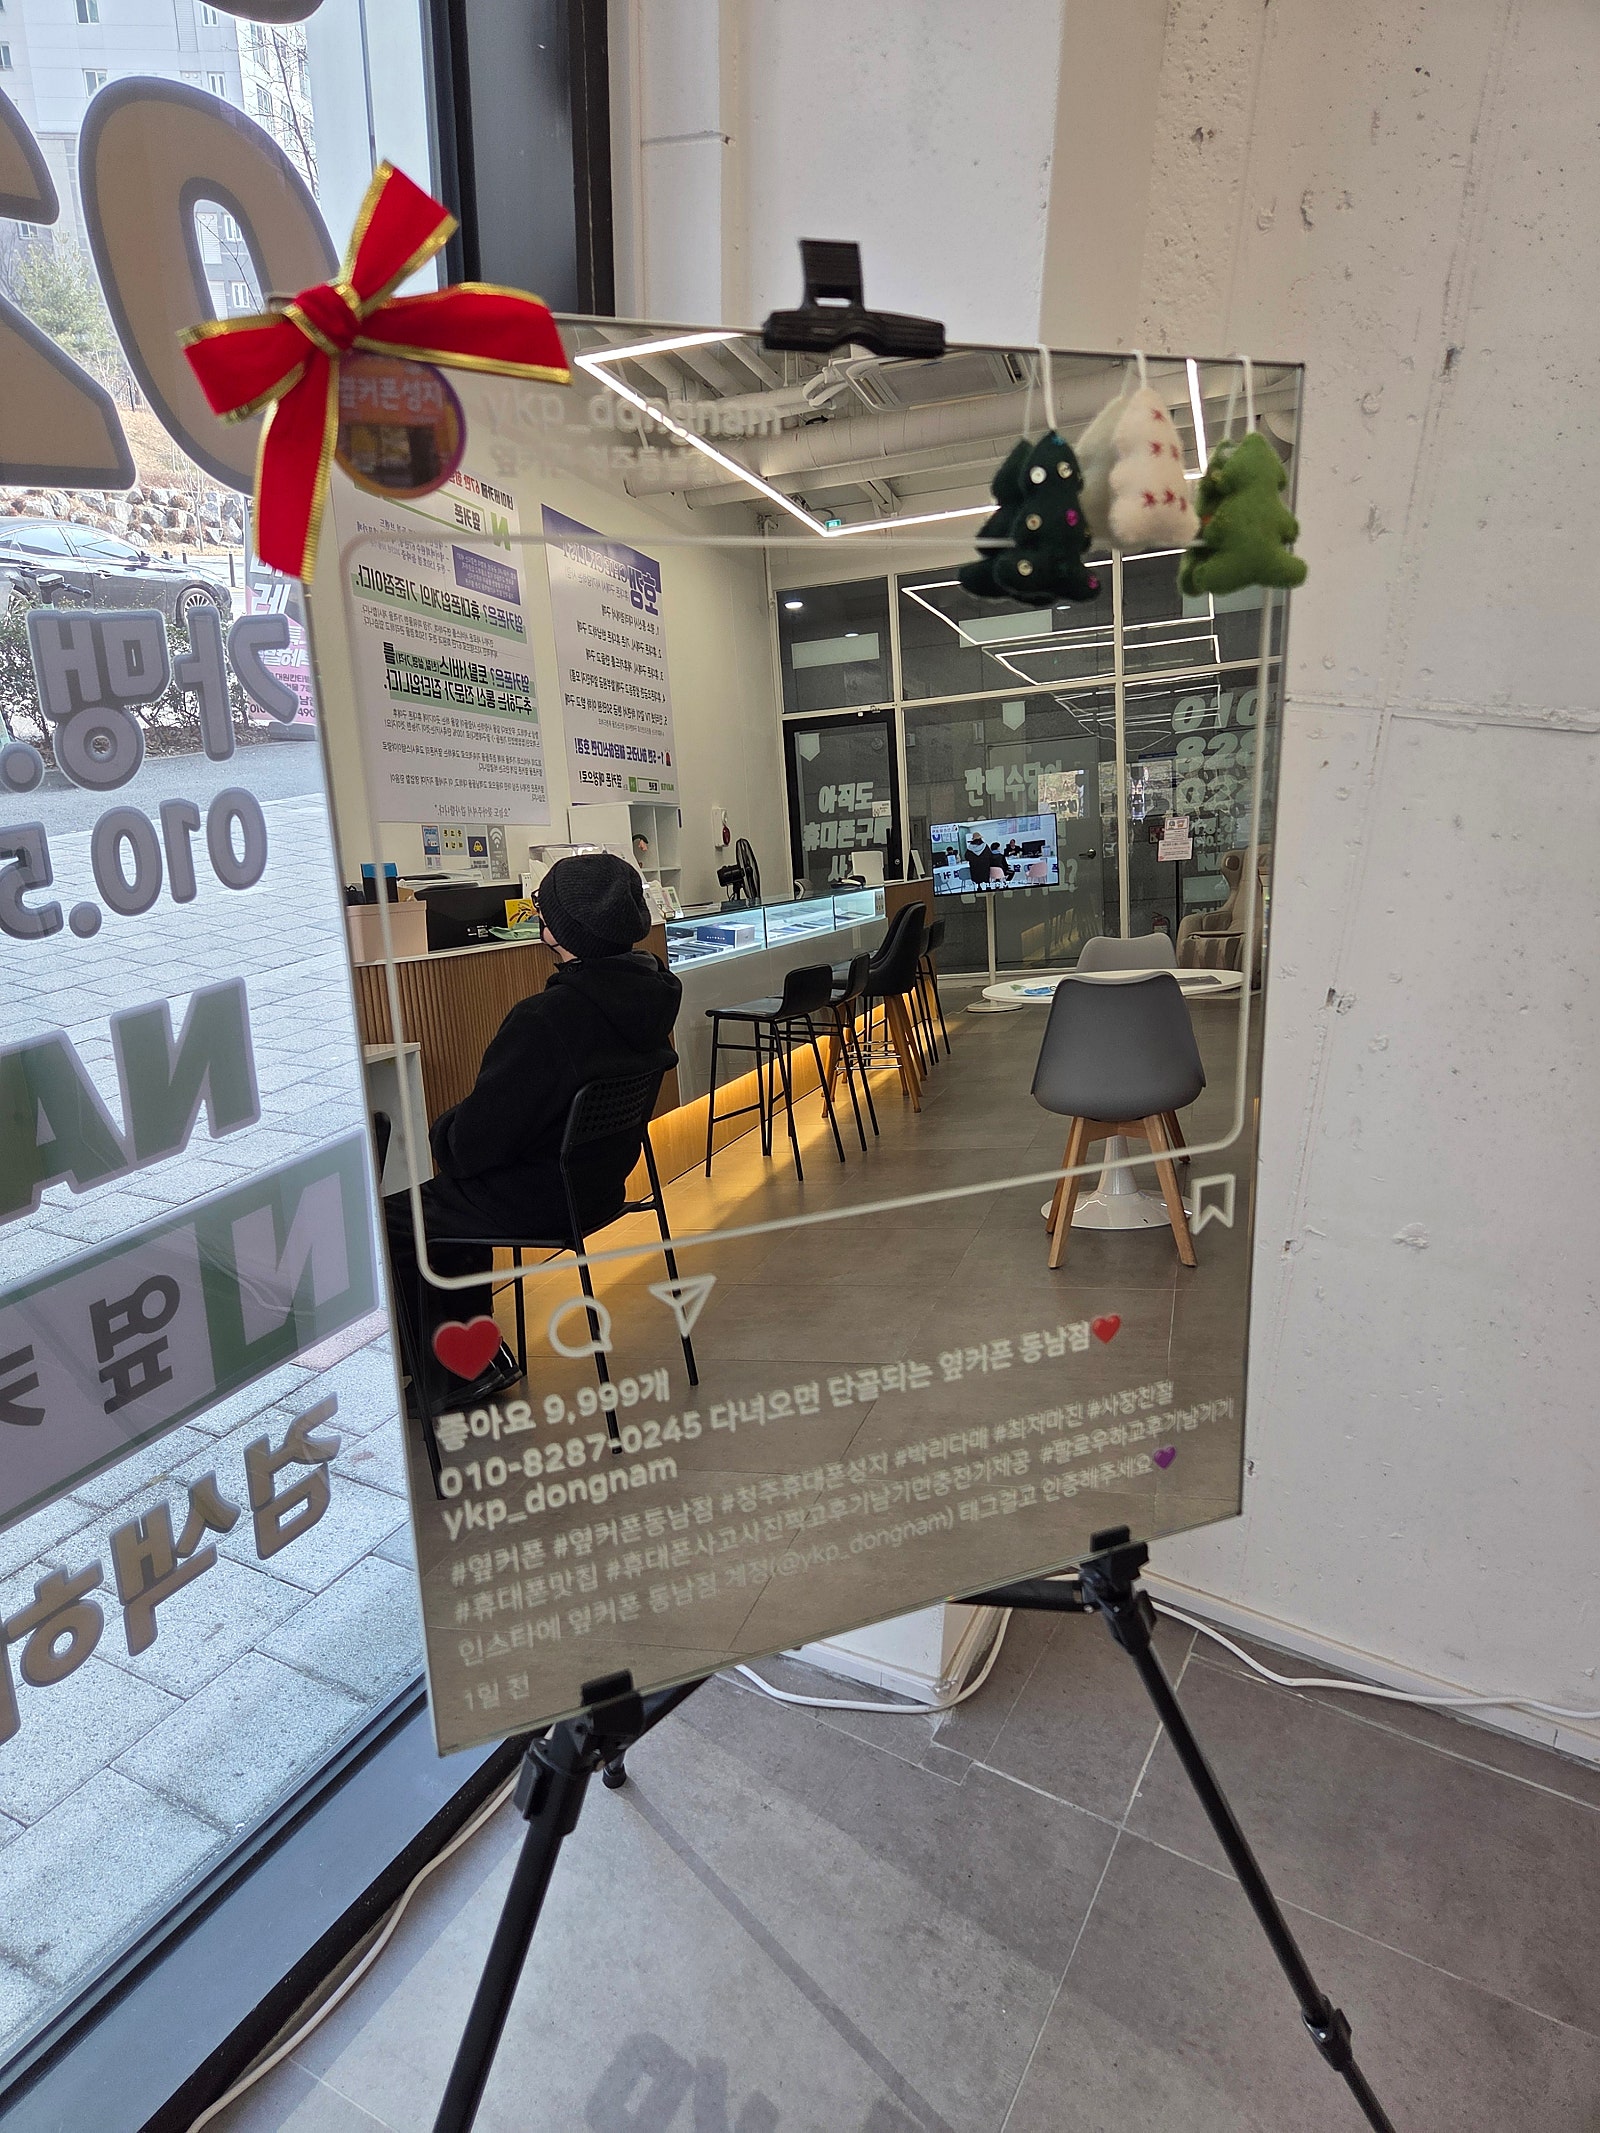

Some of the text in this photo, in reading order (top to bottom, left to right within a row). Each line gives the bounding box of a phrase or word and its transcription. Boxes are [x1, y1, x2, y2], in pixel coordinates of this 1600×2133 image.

[819, 780, 874, 814] 아직도
[434, 1366, 671, 1454] 좋아요 9,999개
[436, 1318, 1090, 1501] 010-8287-0245 다녀오면 단골되는 옆커폰 동남점
[440, 1449, 678, 1542] ykp_dongnam
